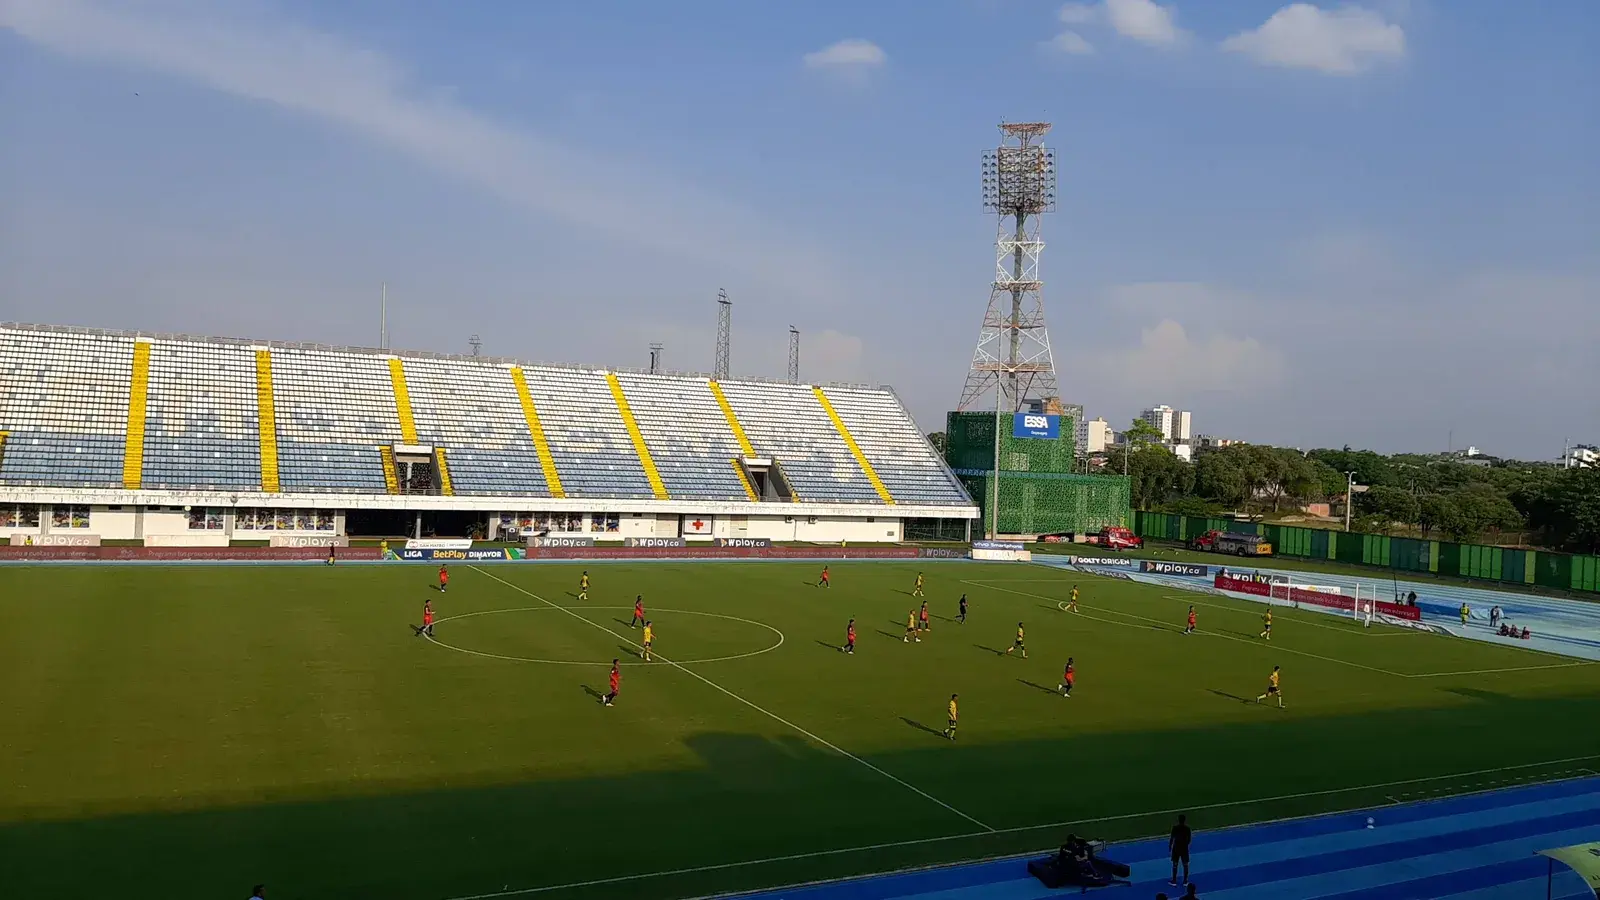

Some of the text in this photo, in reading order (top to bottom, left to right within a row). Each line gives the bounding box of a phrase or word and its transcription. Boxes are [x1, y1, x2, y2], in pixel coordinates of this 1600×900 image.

[1024, 415, 1048, 428] ESSA
[289, 536, 340, 548] Wplay.co
[543, 537, 587, 548] Wplay.co
[639, 538, 680, 548] Wplay.co
[728, 538, 765, 548] Wplay.co
[433, 550, 467, 559] BetPlay
[469, 551, 502, 559] DIMAYOR
[1078, 556, 1130, 565] GOLTY ORIGEN
[1155, 563, 1200, 575] Wplay.co
